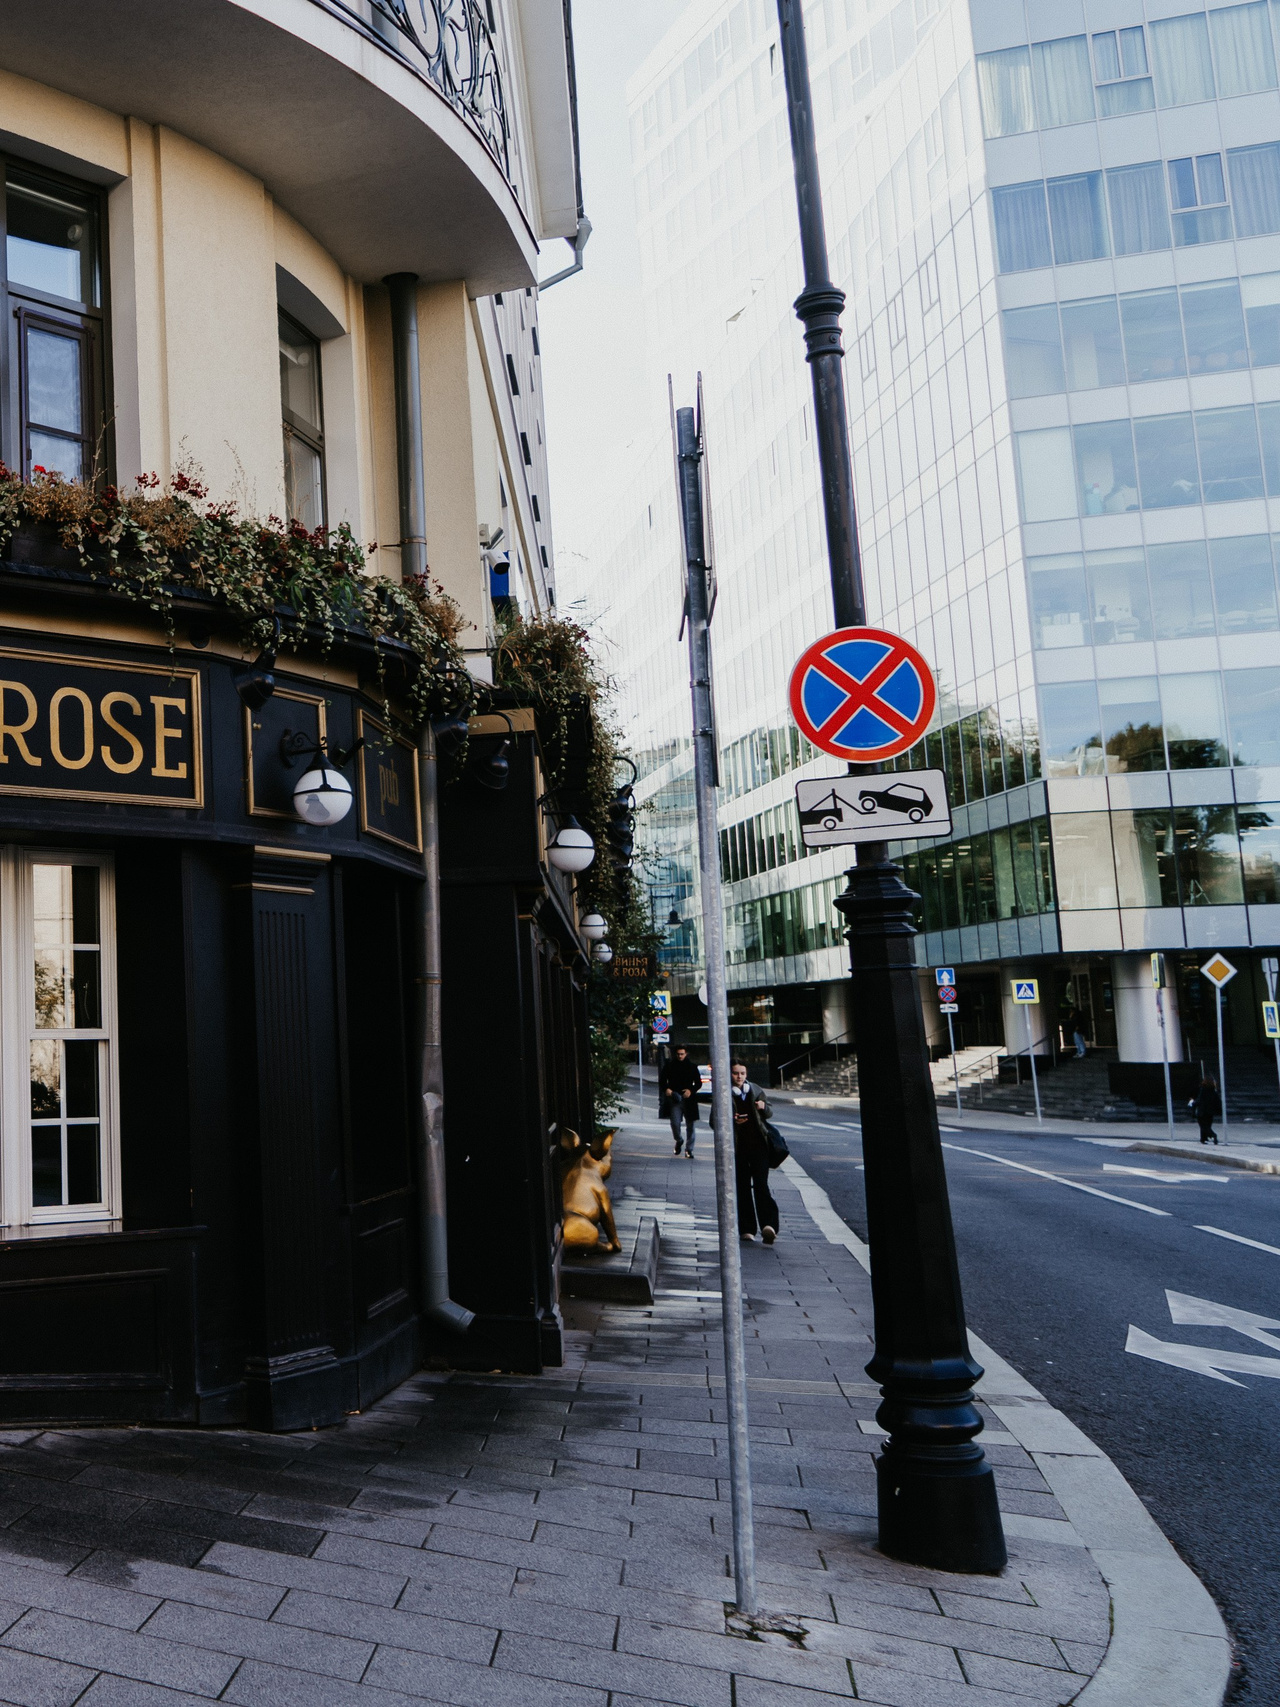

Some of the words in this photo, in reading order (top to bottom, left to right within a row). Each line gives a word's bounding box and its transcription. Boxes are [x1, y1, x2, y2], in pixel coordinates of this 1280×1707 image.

[379, 759, 399, 816] pub
[613, 967, 620, 977] &
[622, 967, 648, 977] РОЗА
